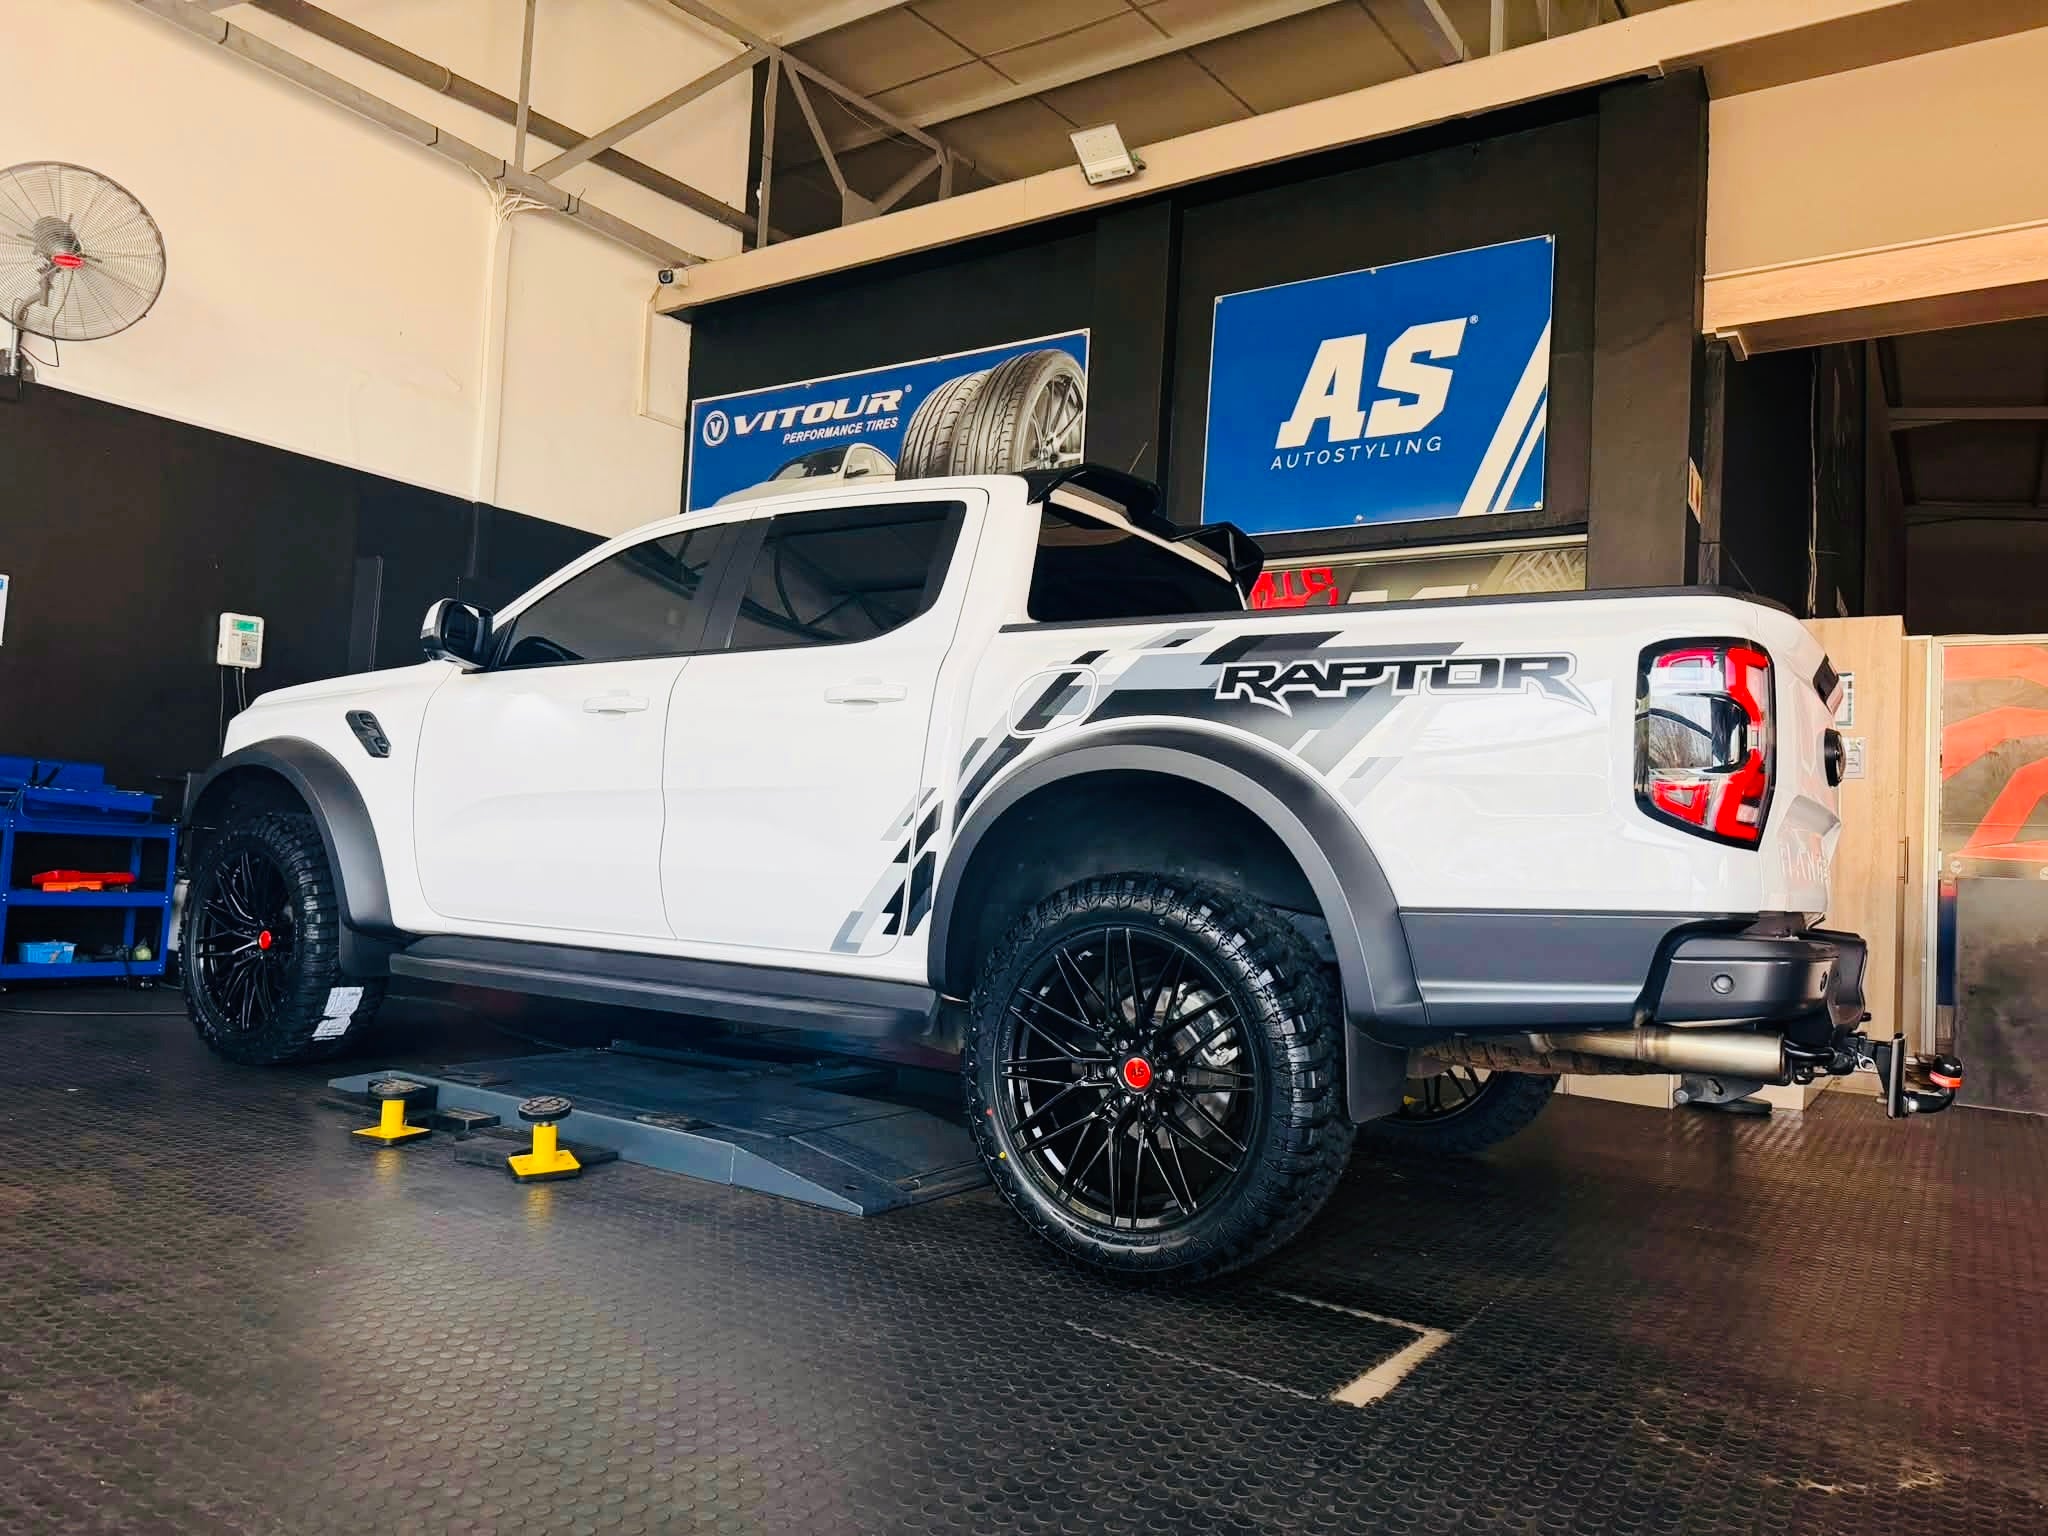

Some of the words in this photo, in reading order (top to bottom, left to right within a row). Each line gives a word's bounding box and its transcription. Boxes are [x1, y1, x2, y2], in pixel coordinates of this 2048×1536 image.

[1274, 317, 1468, 450] AS
[733, 389, 904, 435] VITOUR
[782, 423, 863, 445] PERFORMANCE
[865, 416, 899, 433] TIRES
[1270, 436, 1442, 470] AUTOSTYLING
[1216, 651, 1597, 718] RAPTOR
